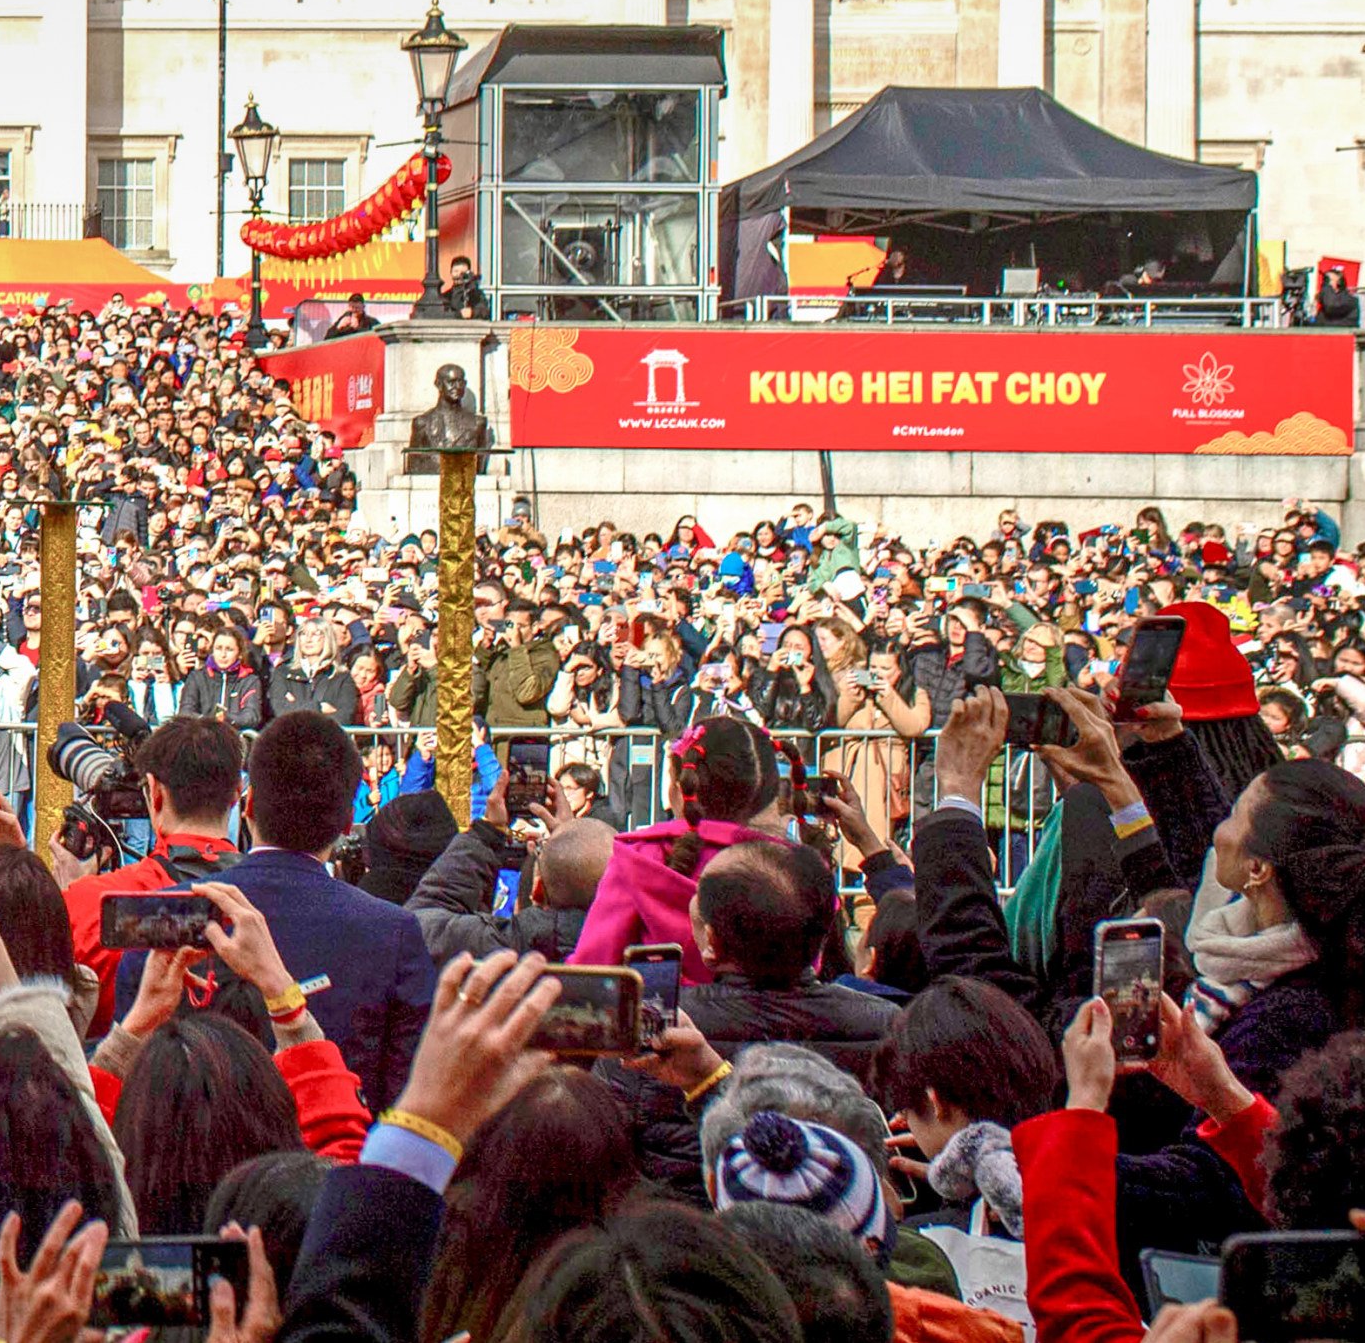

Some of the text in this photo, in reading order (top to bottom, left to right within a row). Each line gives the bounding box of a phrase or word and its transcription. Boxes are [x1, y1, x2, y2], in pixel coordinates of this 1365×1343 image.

[749, 371, 1107, 405] KUNG HEI FAT CHOY
[1172, 408, 1245, 419] FULL BLOSSOM
[618, 418, 726, 429] WWW.LCCAUK.COM
[967, 1284, 1017, 1306] RGANIC
